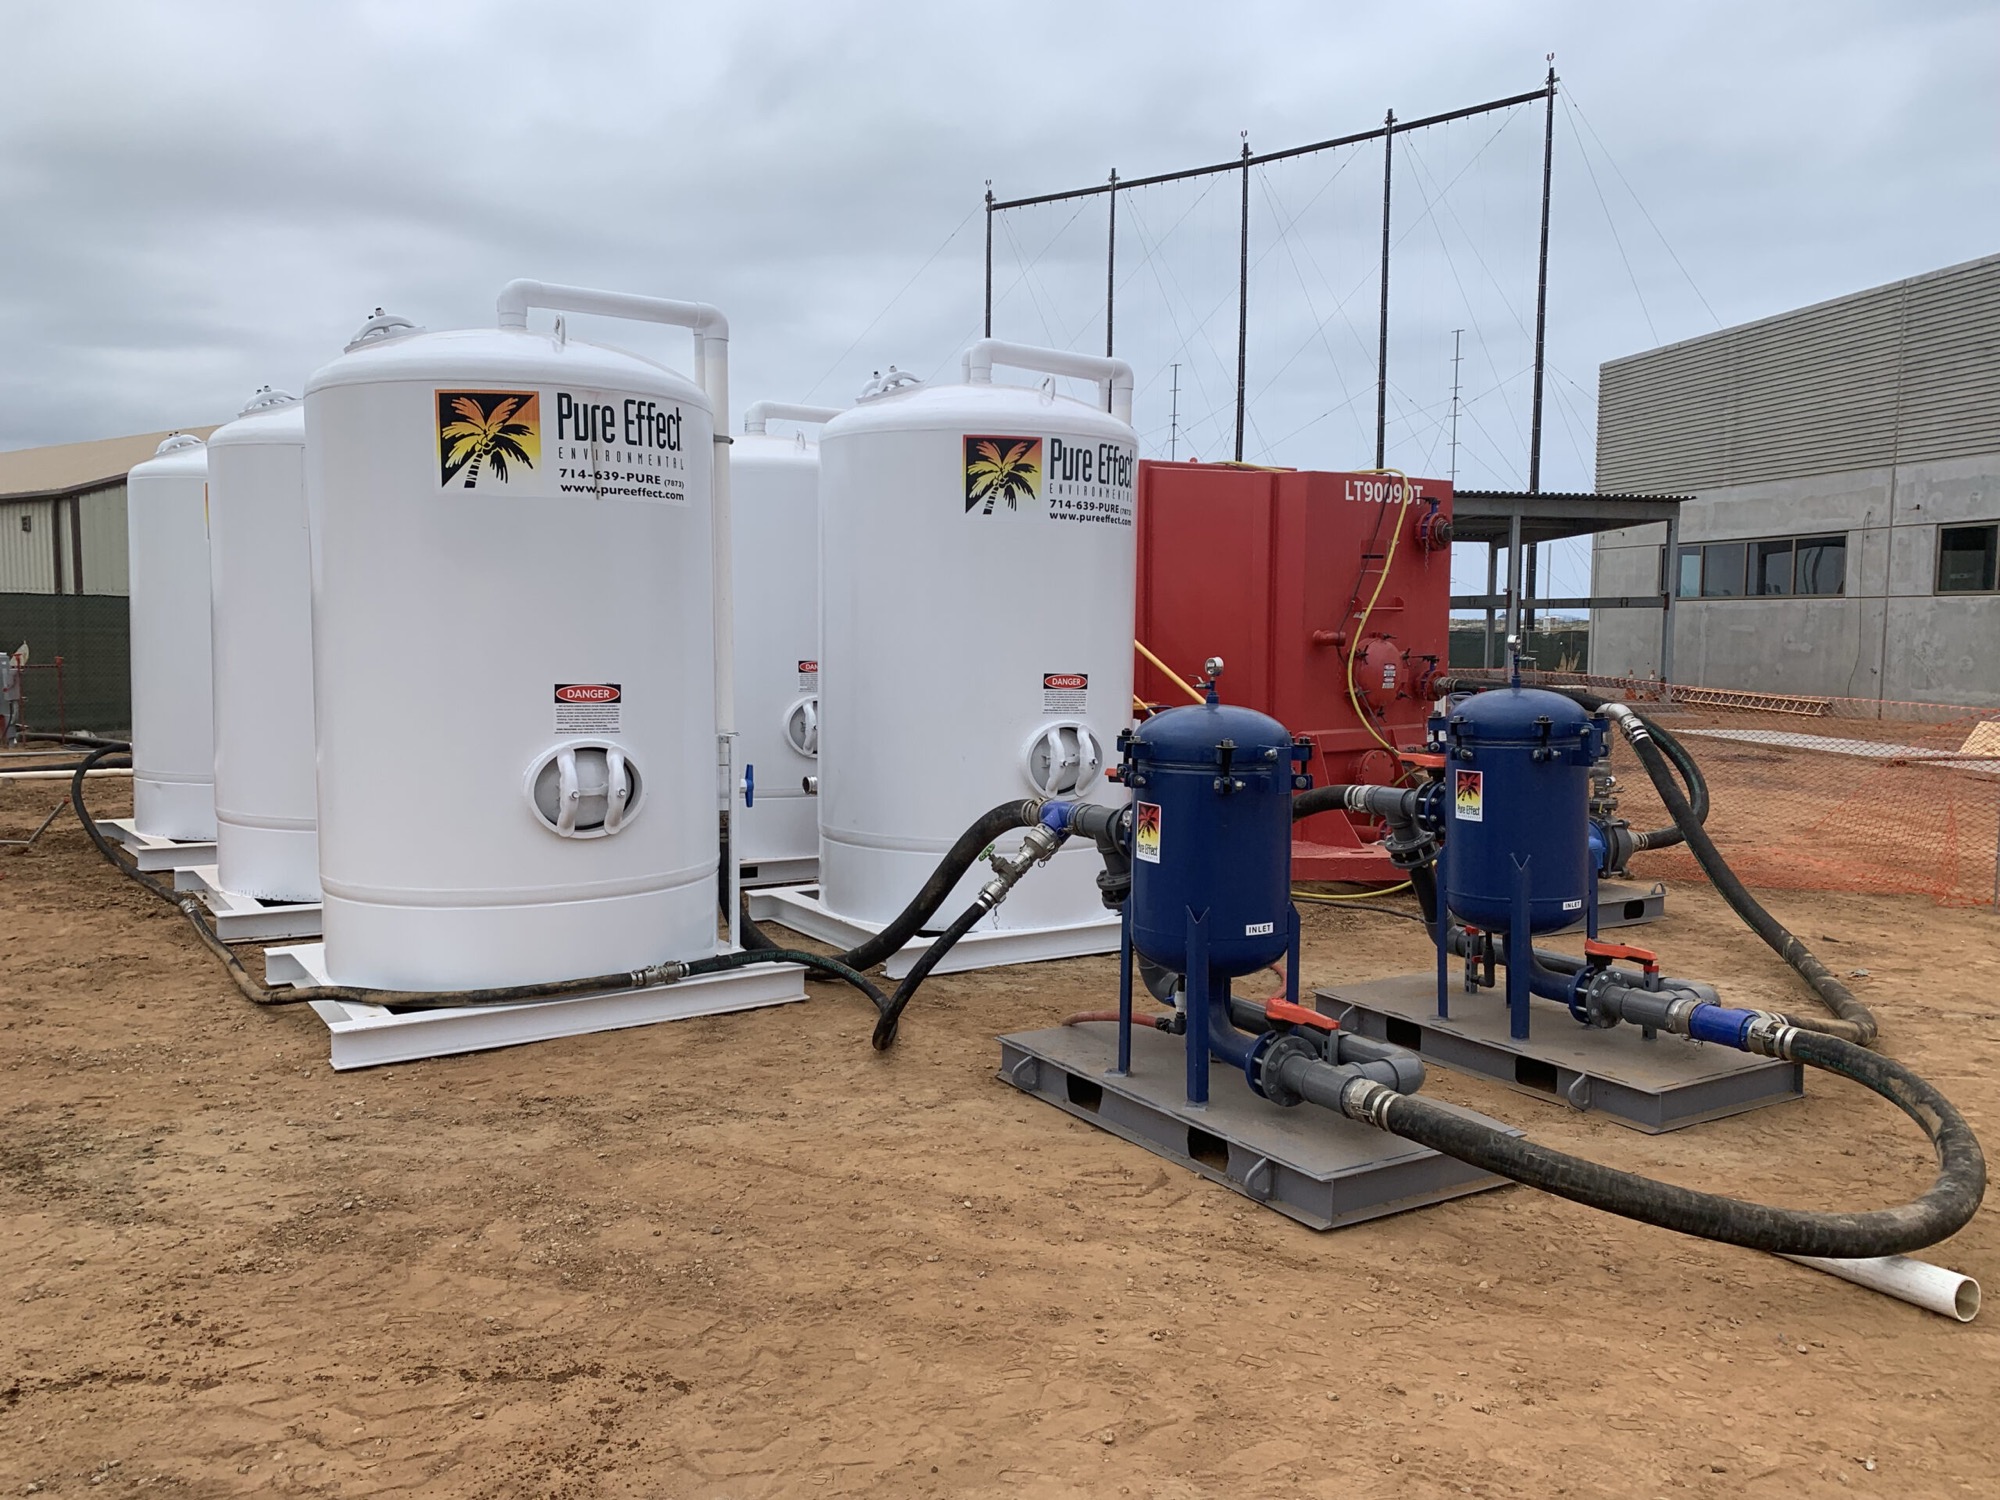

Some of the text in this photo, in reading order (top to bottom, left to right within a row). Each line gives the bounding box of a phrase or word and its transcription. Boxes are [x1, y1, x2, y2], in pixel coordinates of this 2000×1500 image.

[557, 392, 682, 451] Pure Effect
[558, 447, 684, 470] ENVIRONMENTAL
[1050, 438, 1133, 489] Pure Effect
[559, 468, 685, 489] 714-639-PURE (7873)
[560, 484, 684, 501] www.pureeffect.com
[1049, 499, 1119, 513] 714-639-PURE
[1049, 512, 1132, 526] www.pureeffect.com
[1052, 677, 1081, 686] DANGER
[567, 689, 610, 698] DANGER
[1145, 844, 1158, 856] Effect
[1248, 924, 1271, 934] INLET
[788, 951, 817, 964] GENERAL
